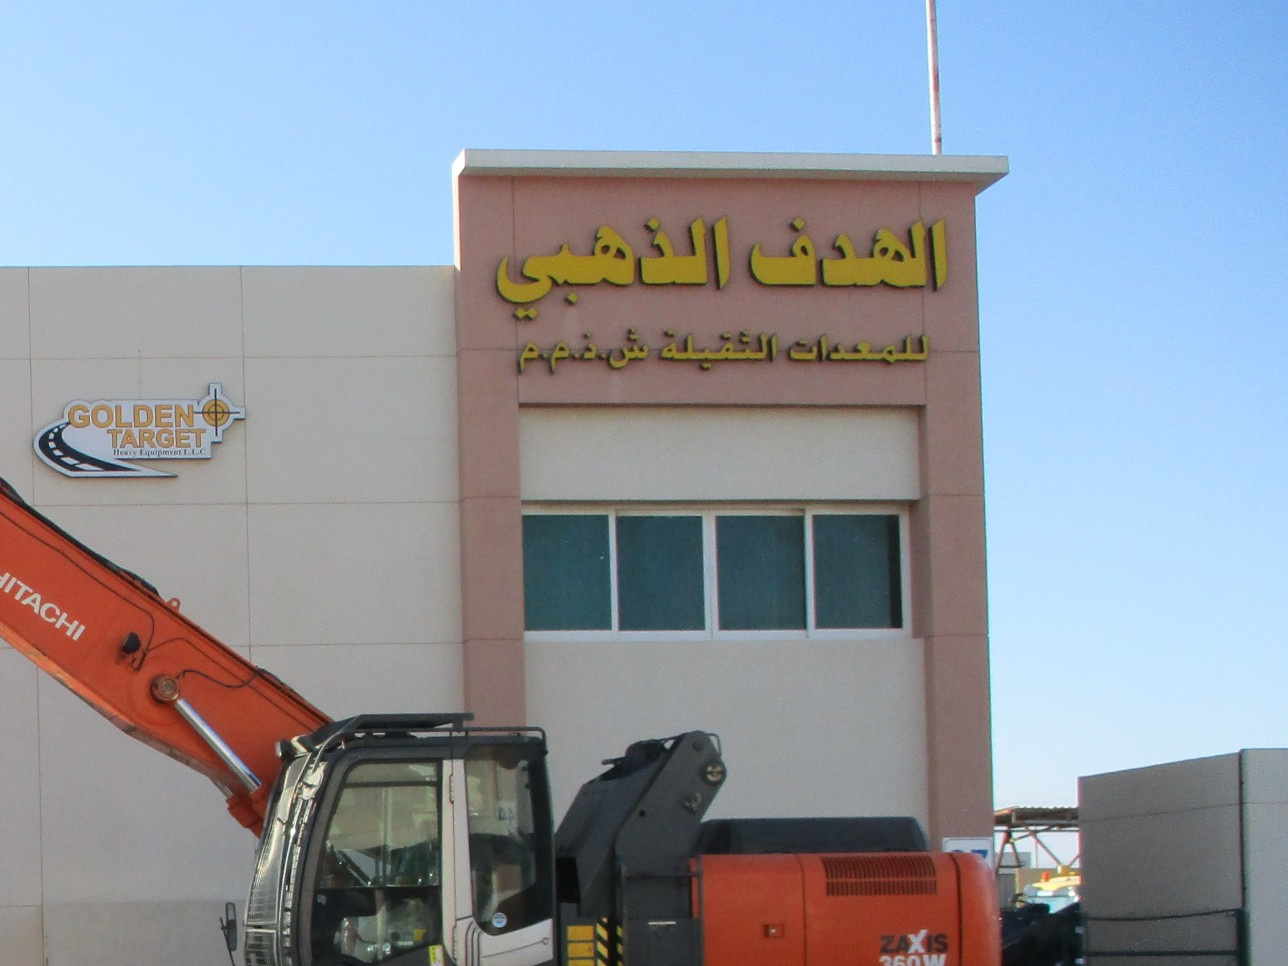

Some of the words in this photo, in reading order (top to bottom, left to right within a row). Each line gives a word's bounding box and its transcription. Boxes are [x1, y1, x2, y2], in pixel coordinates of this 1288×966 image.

[750, 216, 947, 290] الهدف
[495, 216, 729, 321] الذهبي
[661, 328, 778, 370] الثقيلة
[789, 333, 930, 366] للمعدات
[68, 404, 195, 428] GOLDEN
[107, 429, 206, 448] TARGET
[113, 448, 137, 457] Heavy
[140, 448, 181, 457] Equipment
[880, 929, 949, 954] ZAXIS
